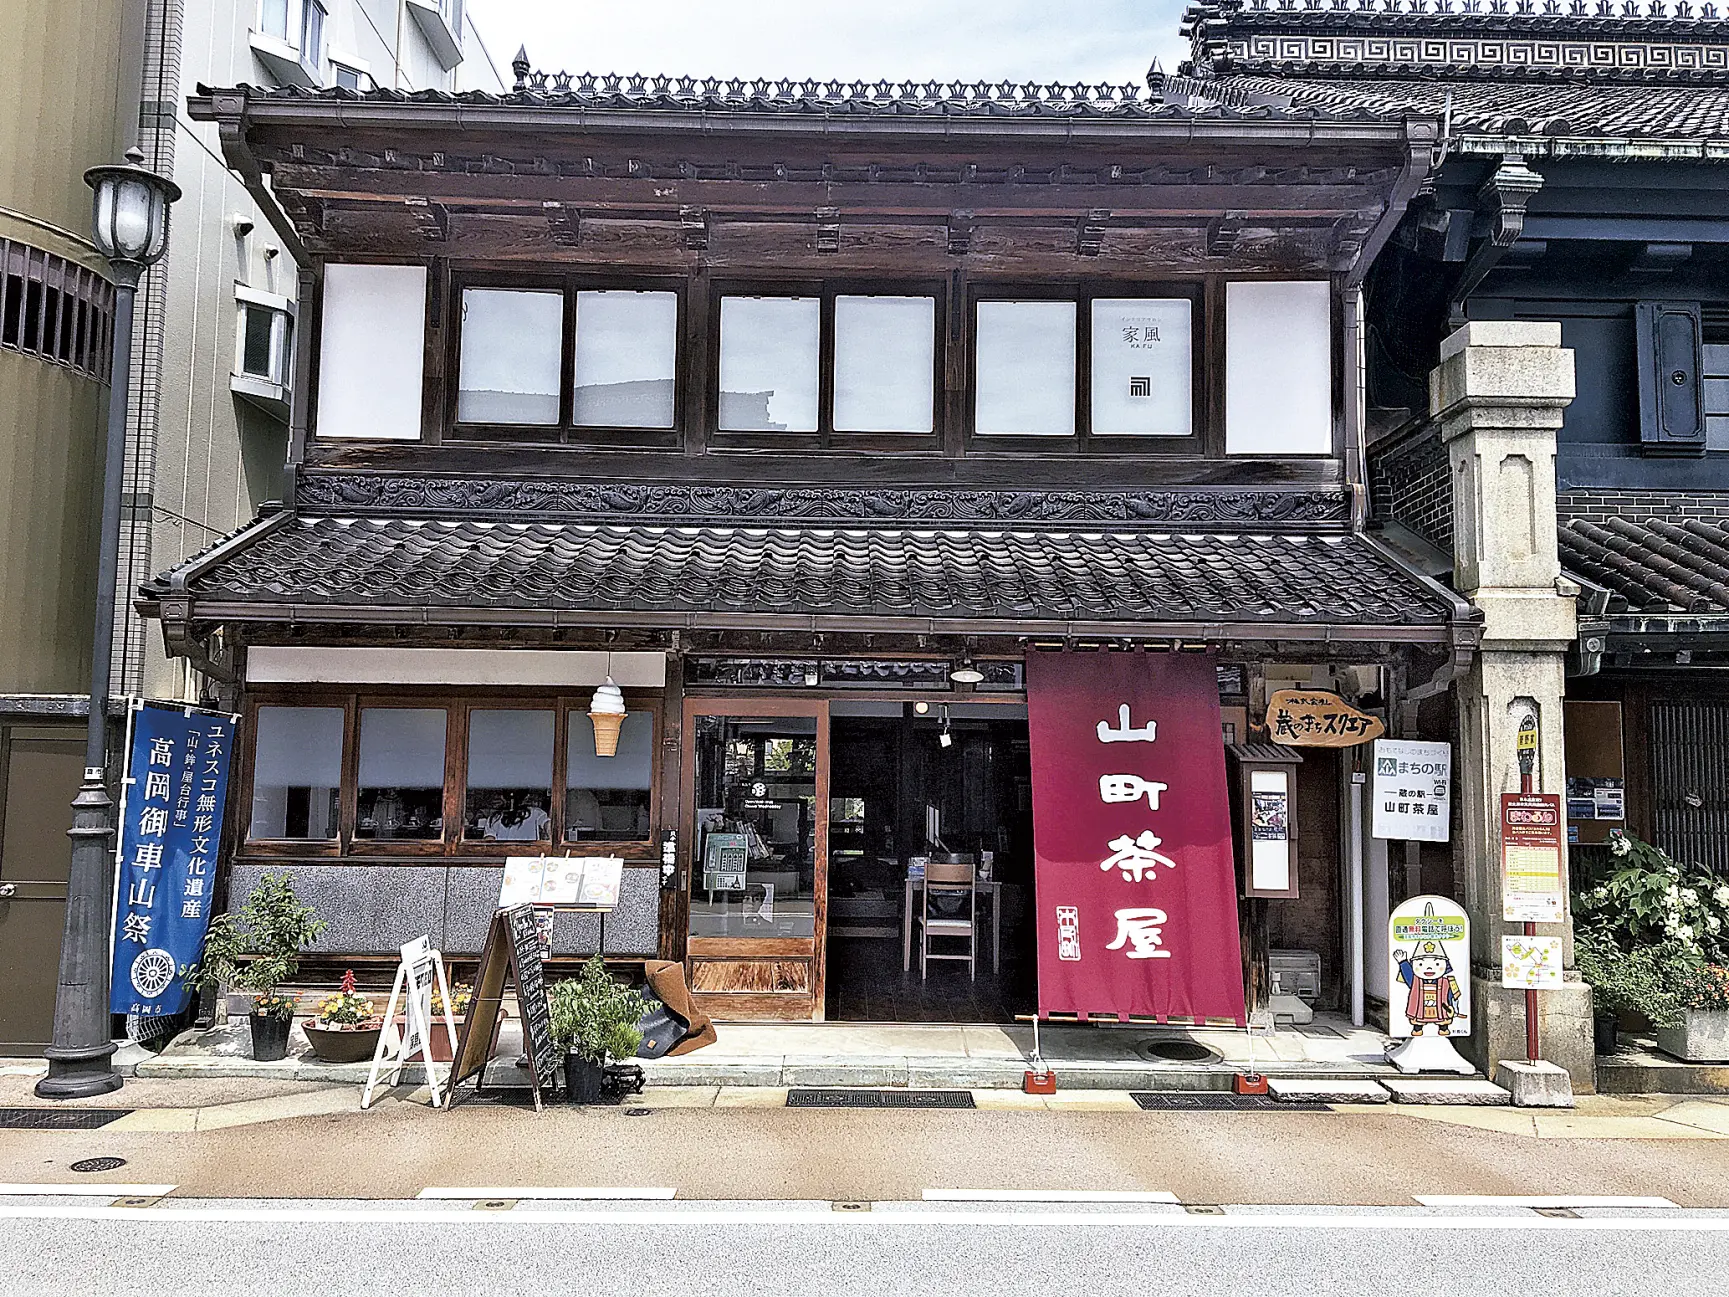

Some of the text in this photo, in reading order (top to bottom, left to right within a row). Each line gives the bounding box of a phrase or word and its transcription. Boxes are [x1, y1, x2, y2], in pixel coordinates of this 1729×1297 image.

[1122, 326, 1161, 343] 家風
[1285, 697, 1332, 706] 株式会社
[1275, 708, 1374, 740] 蔵のまちスクエア
[1378, 746, 1450, 758] おもてなしのまちづくり
[1398, 761, 1448, 777] まちの駅
[1398, 788, 1426, 799] 蔵の駅
[1384, 801, 1439, 816] 山町茶屋
[180, 724, 226, 919] ユネスコ無形文化遺産
[1096, 703, 1176, 960] 山町茶屋
[121, 737, 175, 945] 高岡御車山祭
